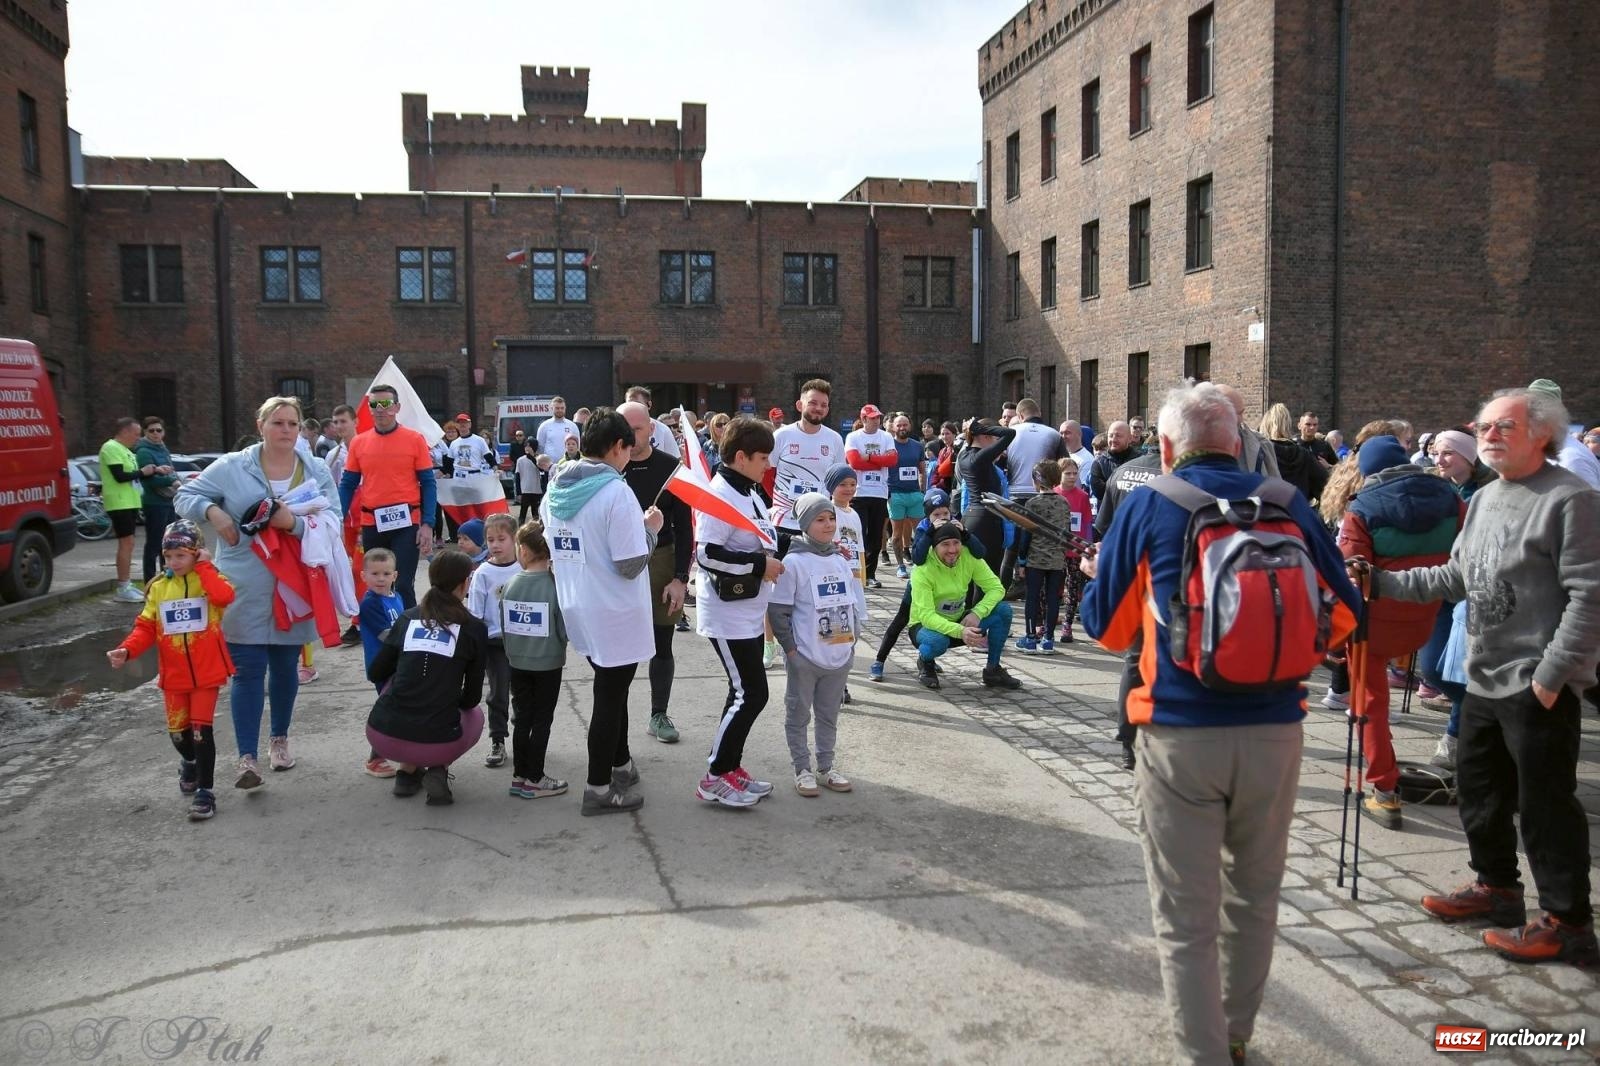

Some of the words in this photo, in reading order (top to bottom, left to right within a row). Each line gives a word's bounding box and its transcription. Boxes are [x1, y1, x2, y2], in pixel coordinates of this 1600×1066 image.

[507, 404, 549, 413] AMBULANS
[0, 424, 52, 438] OCHRONNA
[386, 513, 402, 521] 102
[561, 538, 572, 550] 64
[826, 583, 840, 594] 42
[174, 609, 191, 621] 68
[517, 611, 531, 623] 76
[423, 629, 440, 640] 78
